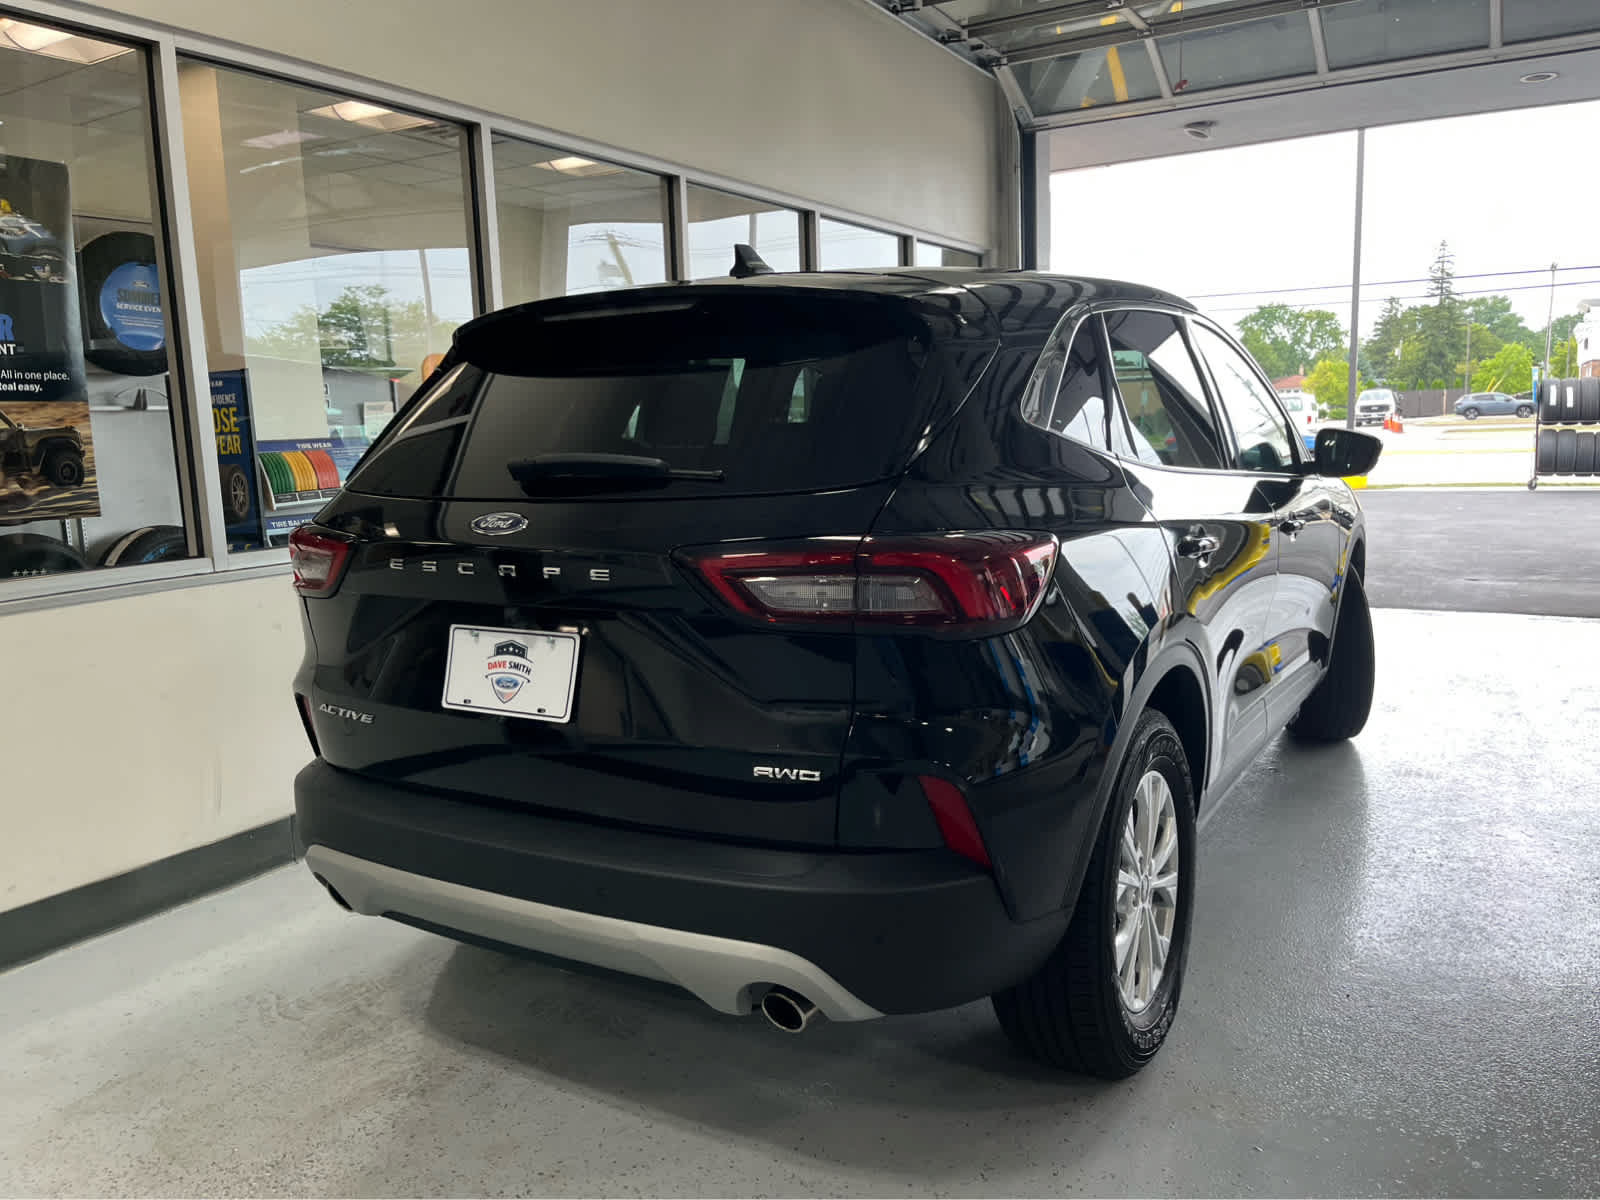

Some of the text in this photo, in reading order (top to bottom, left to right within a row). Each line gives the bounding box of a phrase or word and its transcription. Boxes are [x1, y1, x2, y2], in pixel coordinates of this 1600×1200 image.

[0, 369, 70, 381] All in one place.
[17, 383, 43, 393] easy.
[271, 520, 287, 529] TIRE
[389, 558, 611, 581] ESCAPE
[487, 660, 532, 676] DAVE SMITH
[319, 703, 375, 724] ACTIVE
[753, 766, 821, 782] AWD
